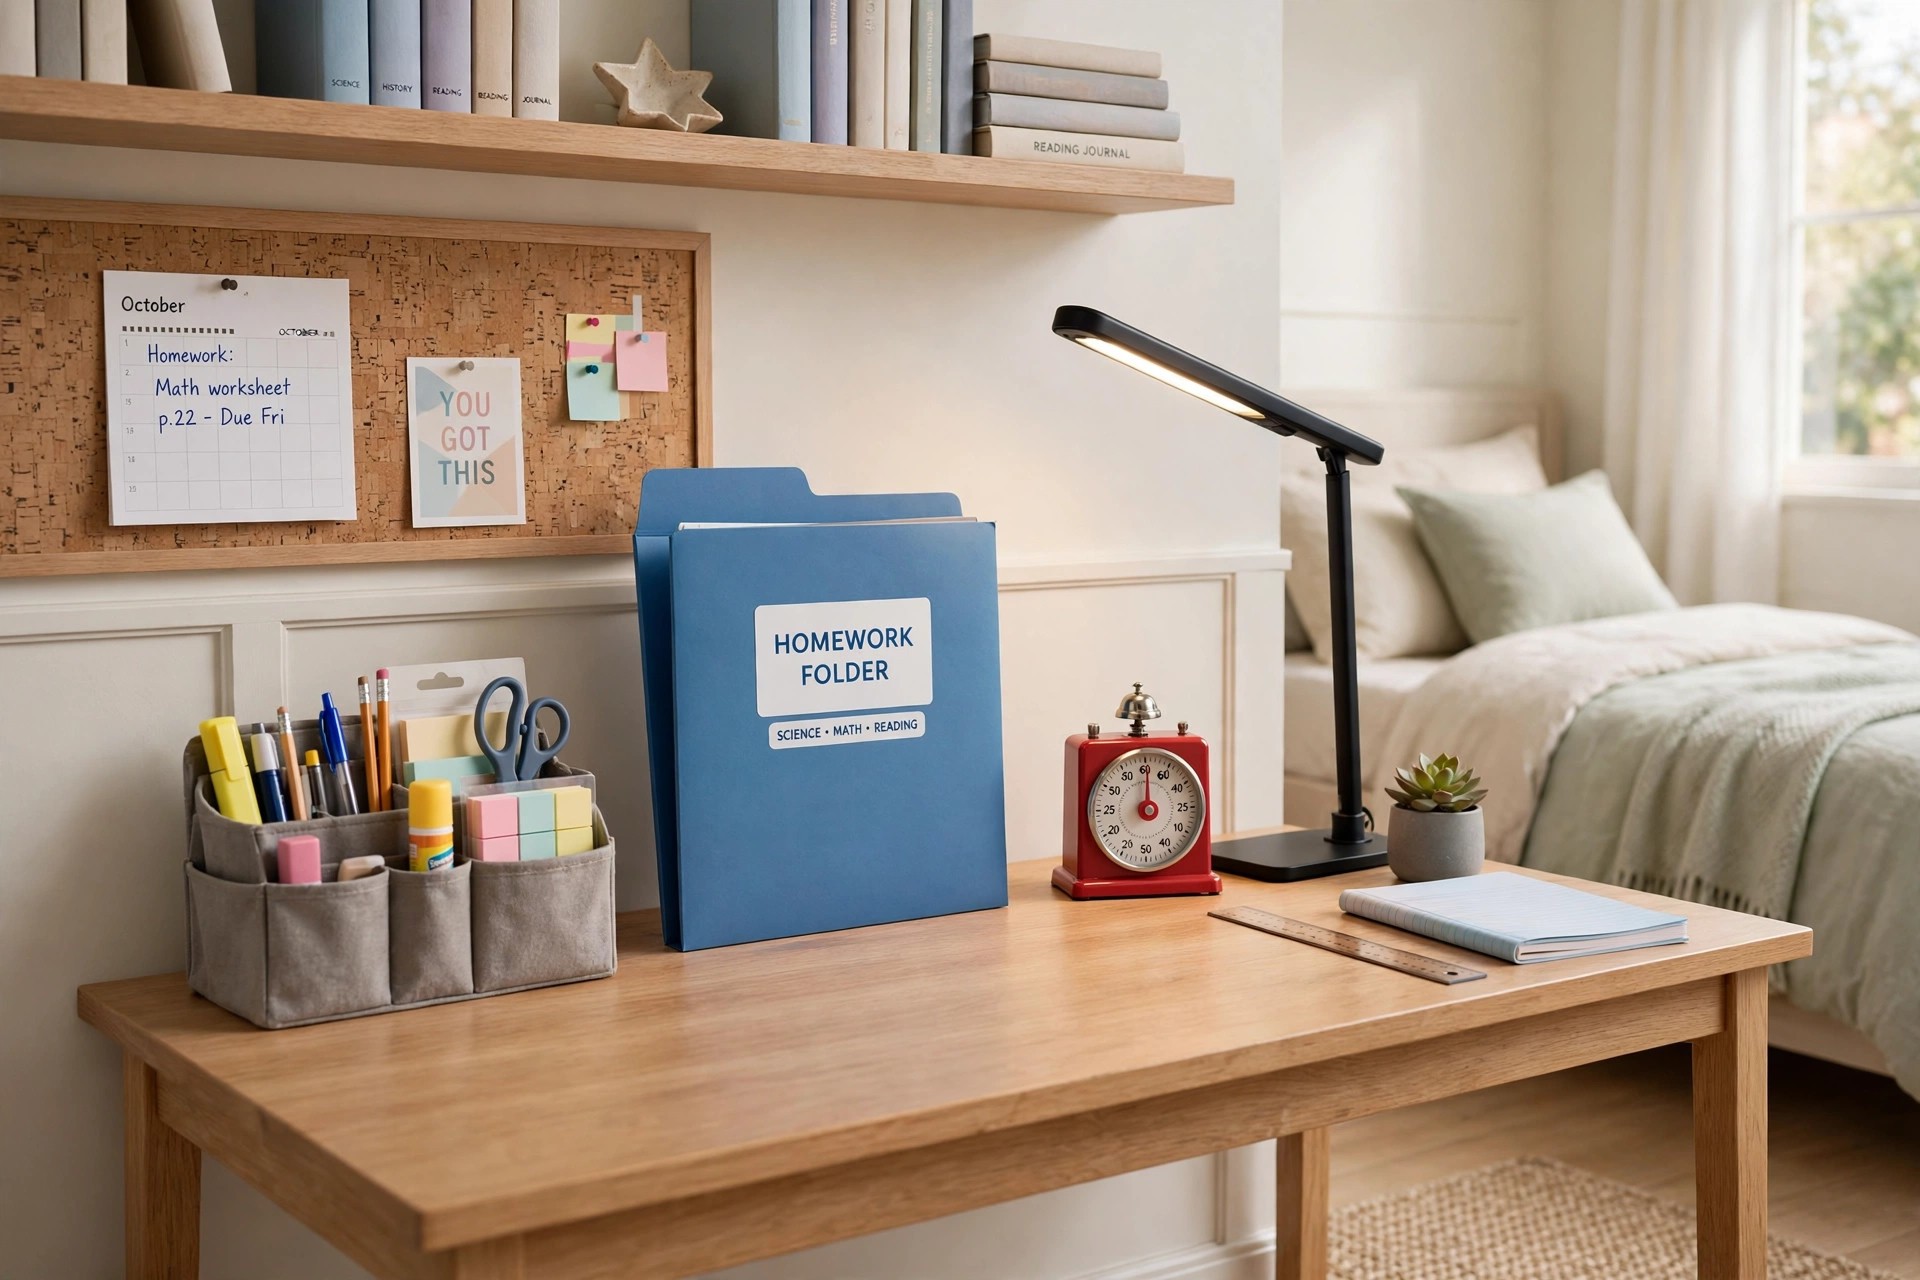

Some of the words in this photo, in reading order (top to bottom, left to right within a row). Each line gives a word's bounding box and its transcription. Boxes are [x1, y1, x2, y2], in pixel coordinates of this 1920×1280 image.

[331, 78, 360, 88] SCIENCE
[382, 82, 413, 93] HISTORY
[432, 86, 462, 97] READING
[478, 91, 508, 102] READING
[522, 96, 552, 106] JOURNAL
[1033, 141, 1080, 155] READING
[1082, 145, 1131, 159] JOURNAL
[121, 296, 186, 313] October
[147, 344, 233, 364] Homework:
[155, 377, 200, 397] Math
[208, 377, 291, 396] worksheet
[439, 391, 490, 417] YOU
[158, 409, 197, 434] p.22
[220, 407, 253, 426] Due
[261, 406, 284, 425] Fri
[440, 426, 491, 452] GOT
[437, 459, 495, 485] THIS
[774, 626, 914, 655] HOMEWORK
[801, 659, 889, 686] FOLDER
[777, 727, 822, 741] SCIENCE
[833, 724, 862, 737] MATH
[874, 718, 918, 733] READING
[1157, 770, 1169, 779] 60
[1109, 786, 1120, 795] 50
[1171, 784, 1183, 793] 40
[1104, 805, 1115, 814] 25
[1177, 803, 1188, 812] 25
[1108, 825, 1119, 834] 20
[1174, 823, 1183, 832] 10
[1159, 838, 1170, 847] 40
[1141, 845, 1151, 853] 50
